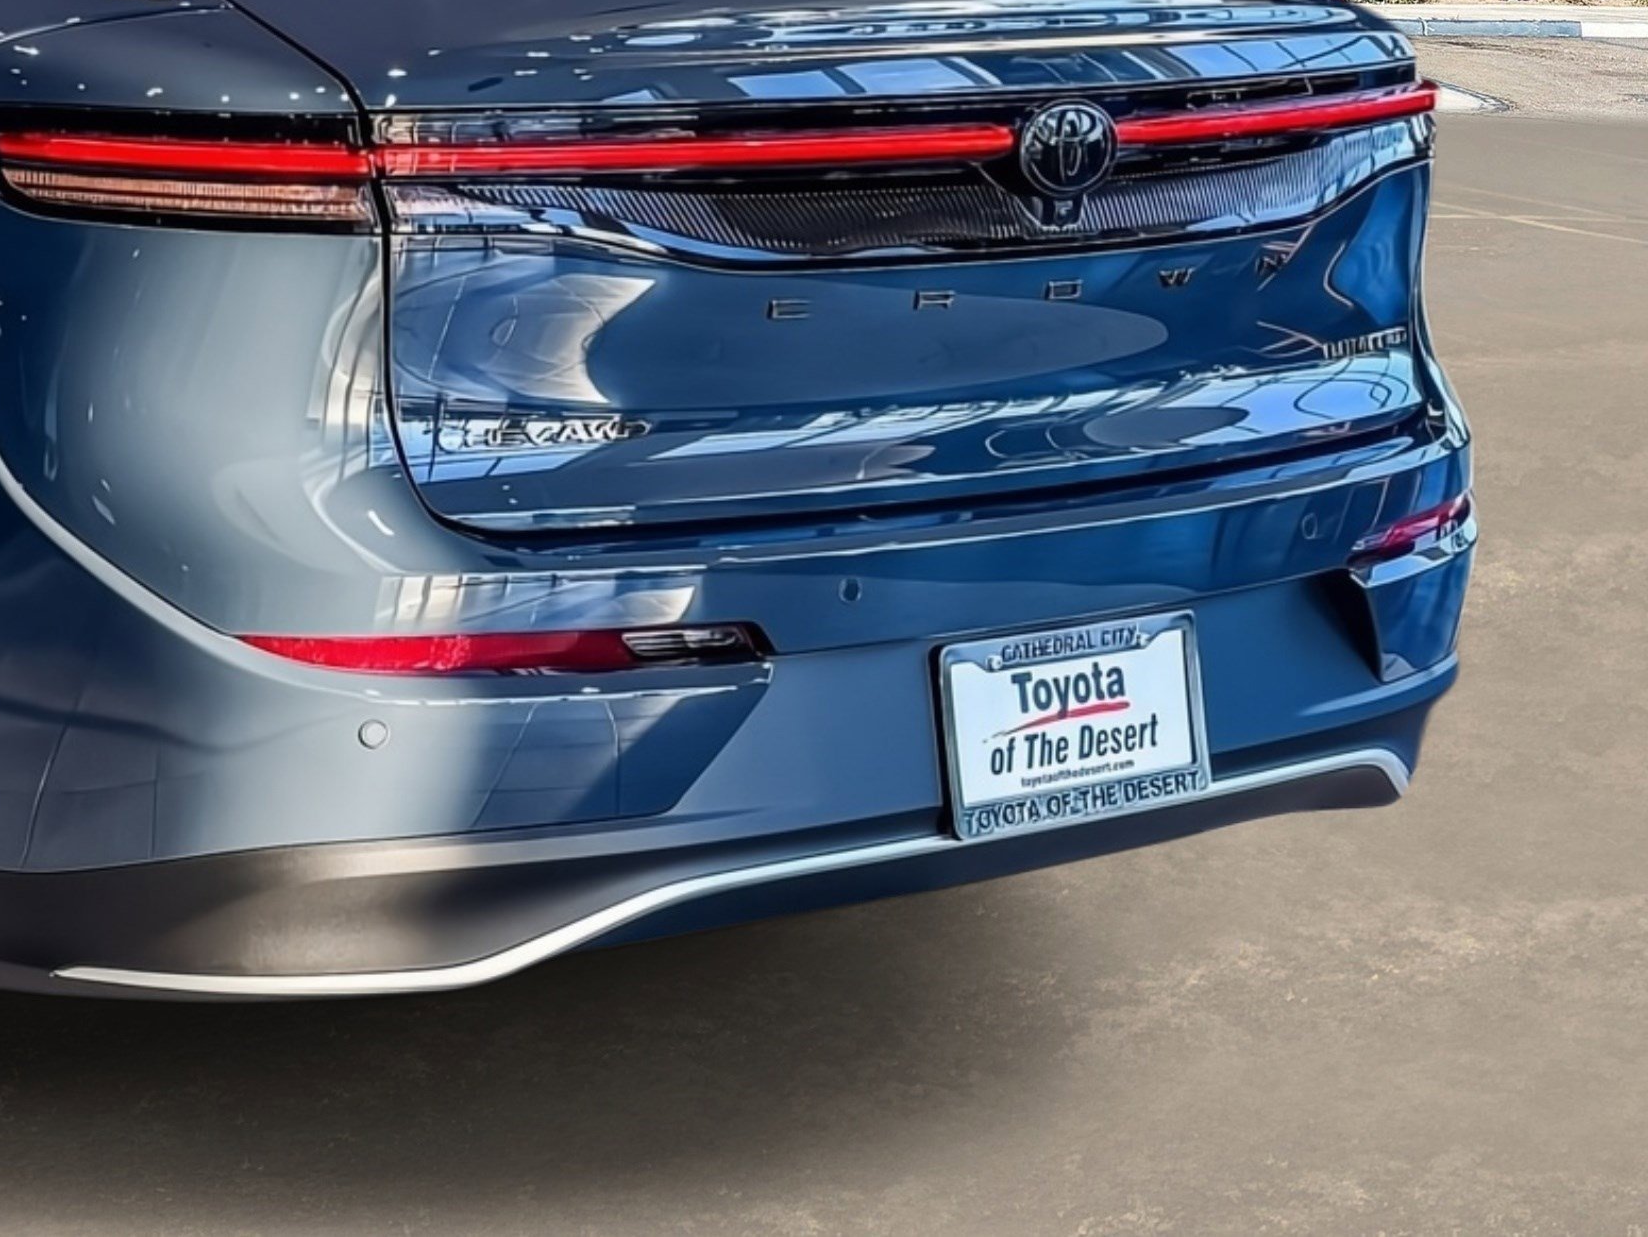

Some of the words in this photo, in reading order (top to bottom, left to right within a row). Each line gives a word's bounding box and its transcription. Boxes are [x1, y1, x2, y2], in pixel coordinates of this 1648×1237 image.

[1001, 629, 1097, 663] CATHEDRAL
[1100, 624, 1138, 648] CITY
[1011, 662, 1126, 719] Toyota
[990, 736, 1016, 776] of
[1024, 731, 1069, 770] The
[1079, 713, 1158, 760] Desert
[965, 798, 1042, 836] TOYOTA
[1046, 794, 1073, 818] OF
[1080, 784, 1119, 811] THE
[1123, 769, 1201, 805] DESERT
